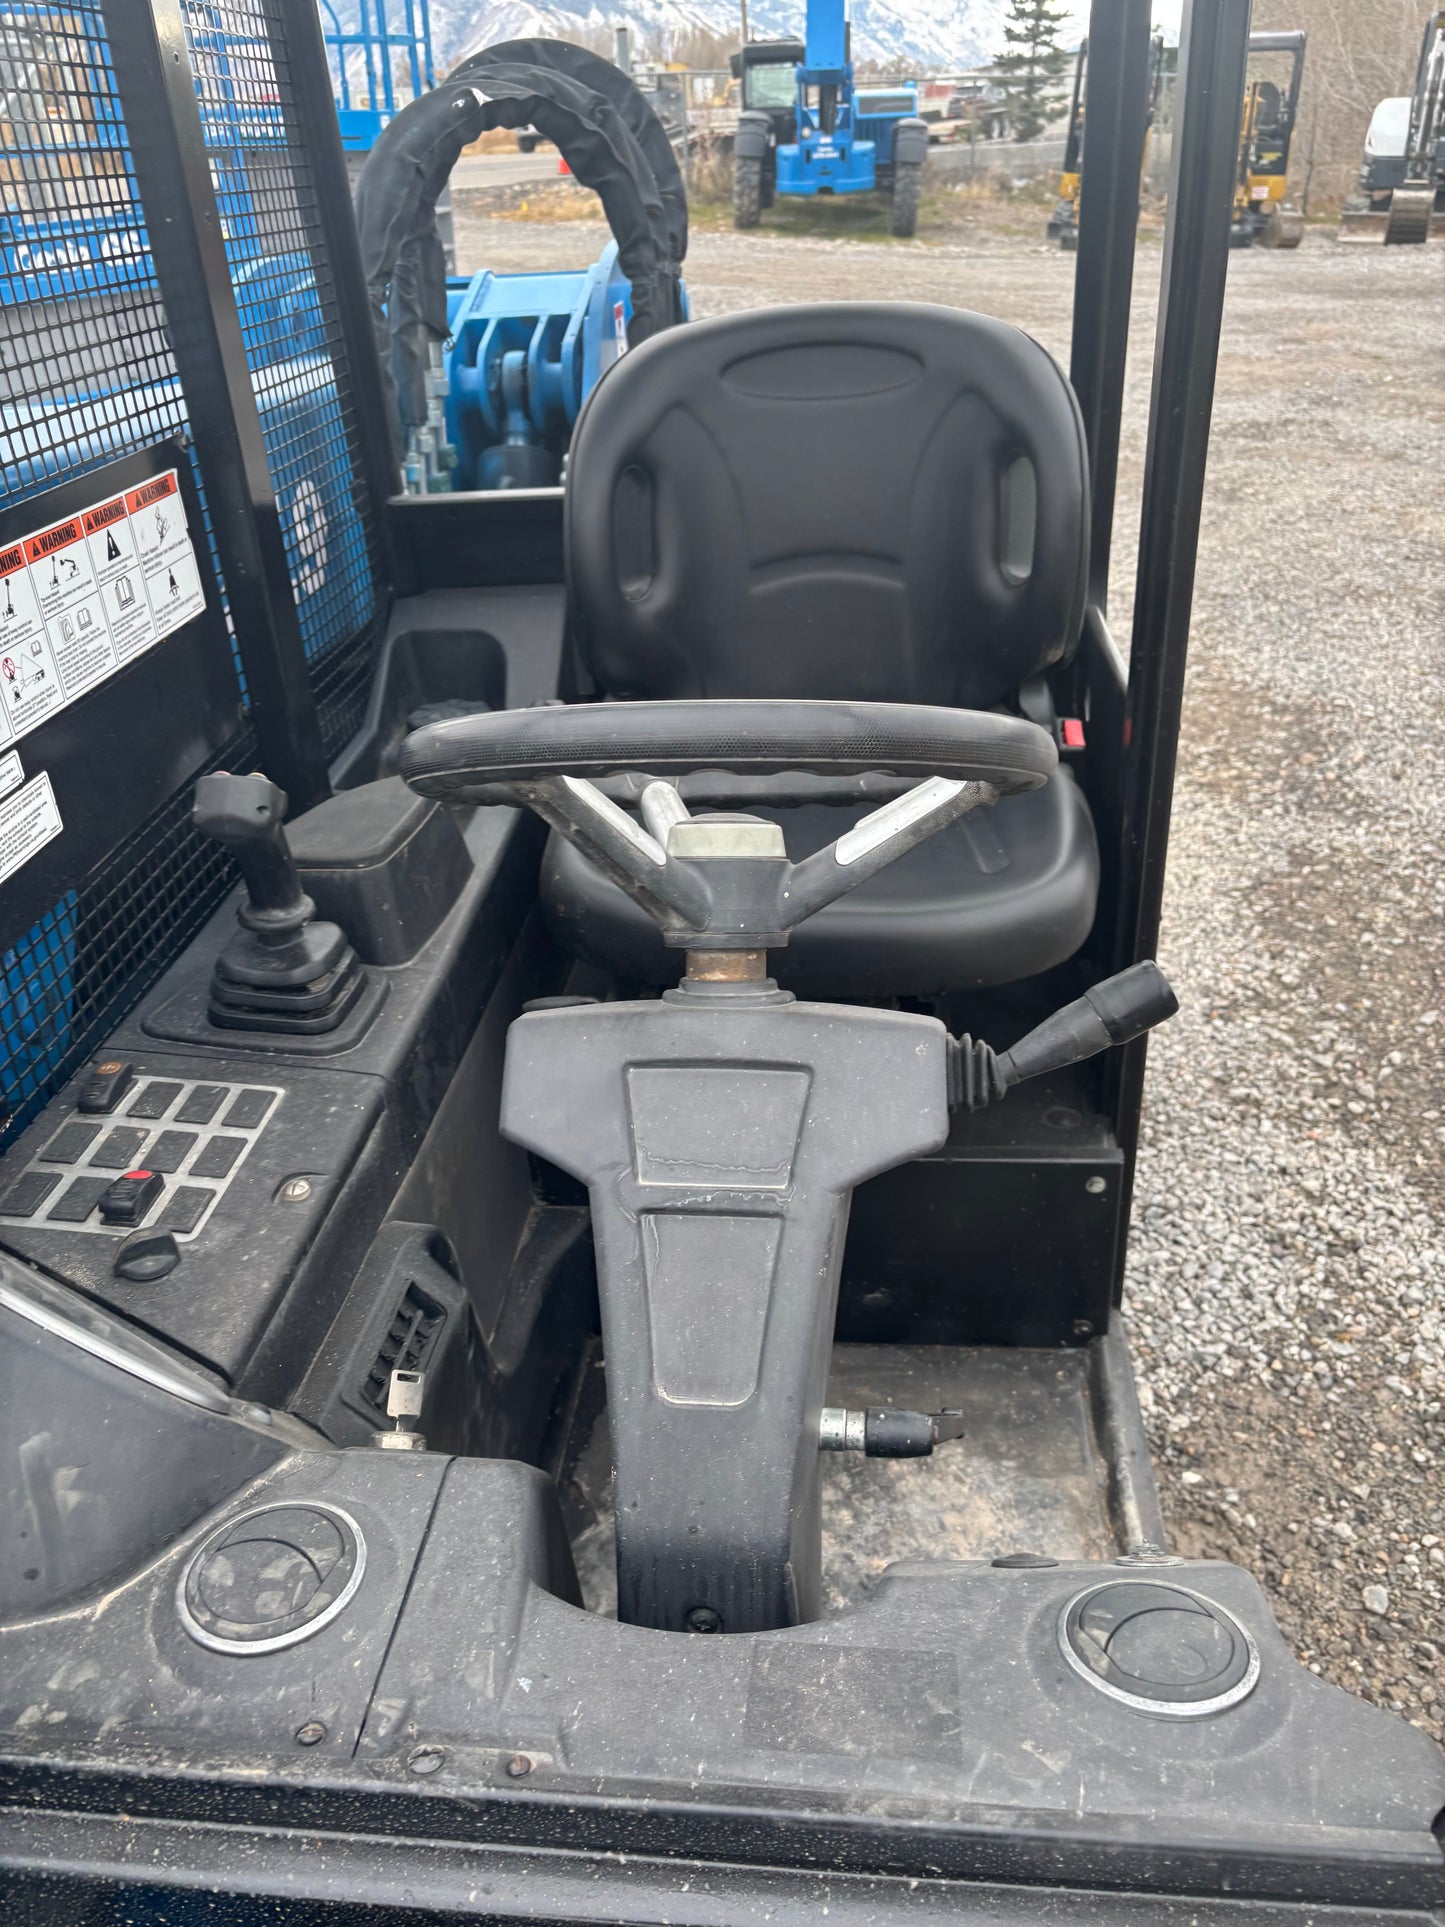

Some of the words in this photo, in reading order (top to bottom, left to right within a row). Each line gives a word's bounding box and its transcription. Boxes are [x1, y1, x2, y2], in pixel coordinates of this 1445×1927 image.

[141, 478, 171, 504] WARNING
[92, 501, 124, 527] WARNING
[39, 523, 77, 553] WARNING
[0, 549, 22, 573] NING
